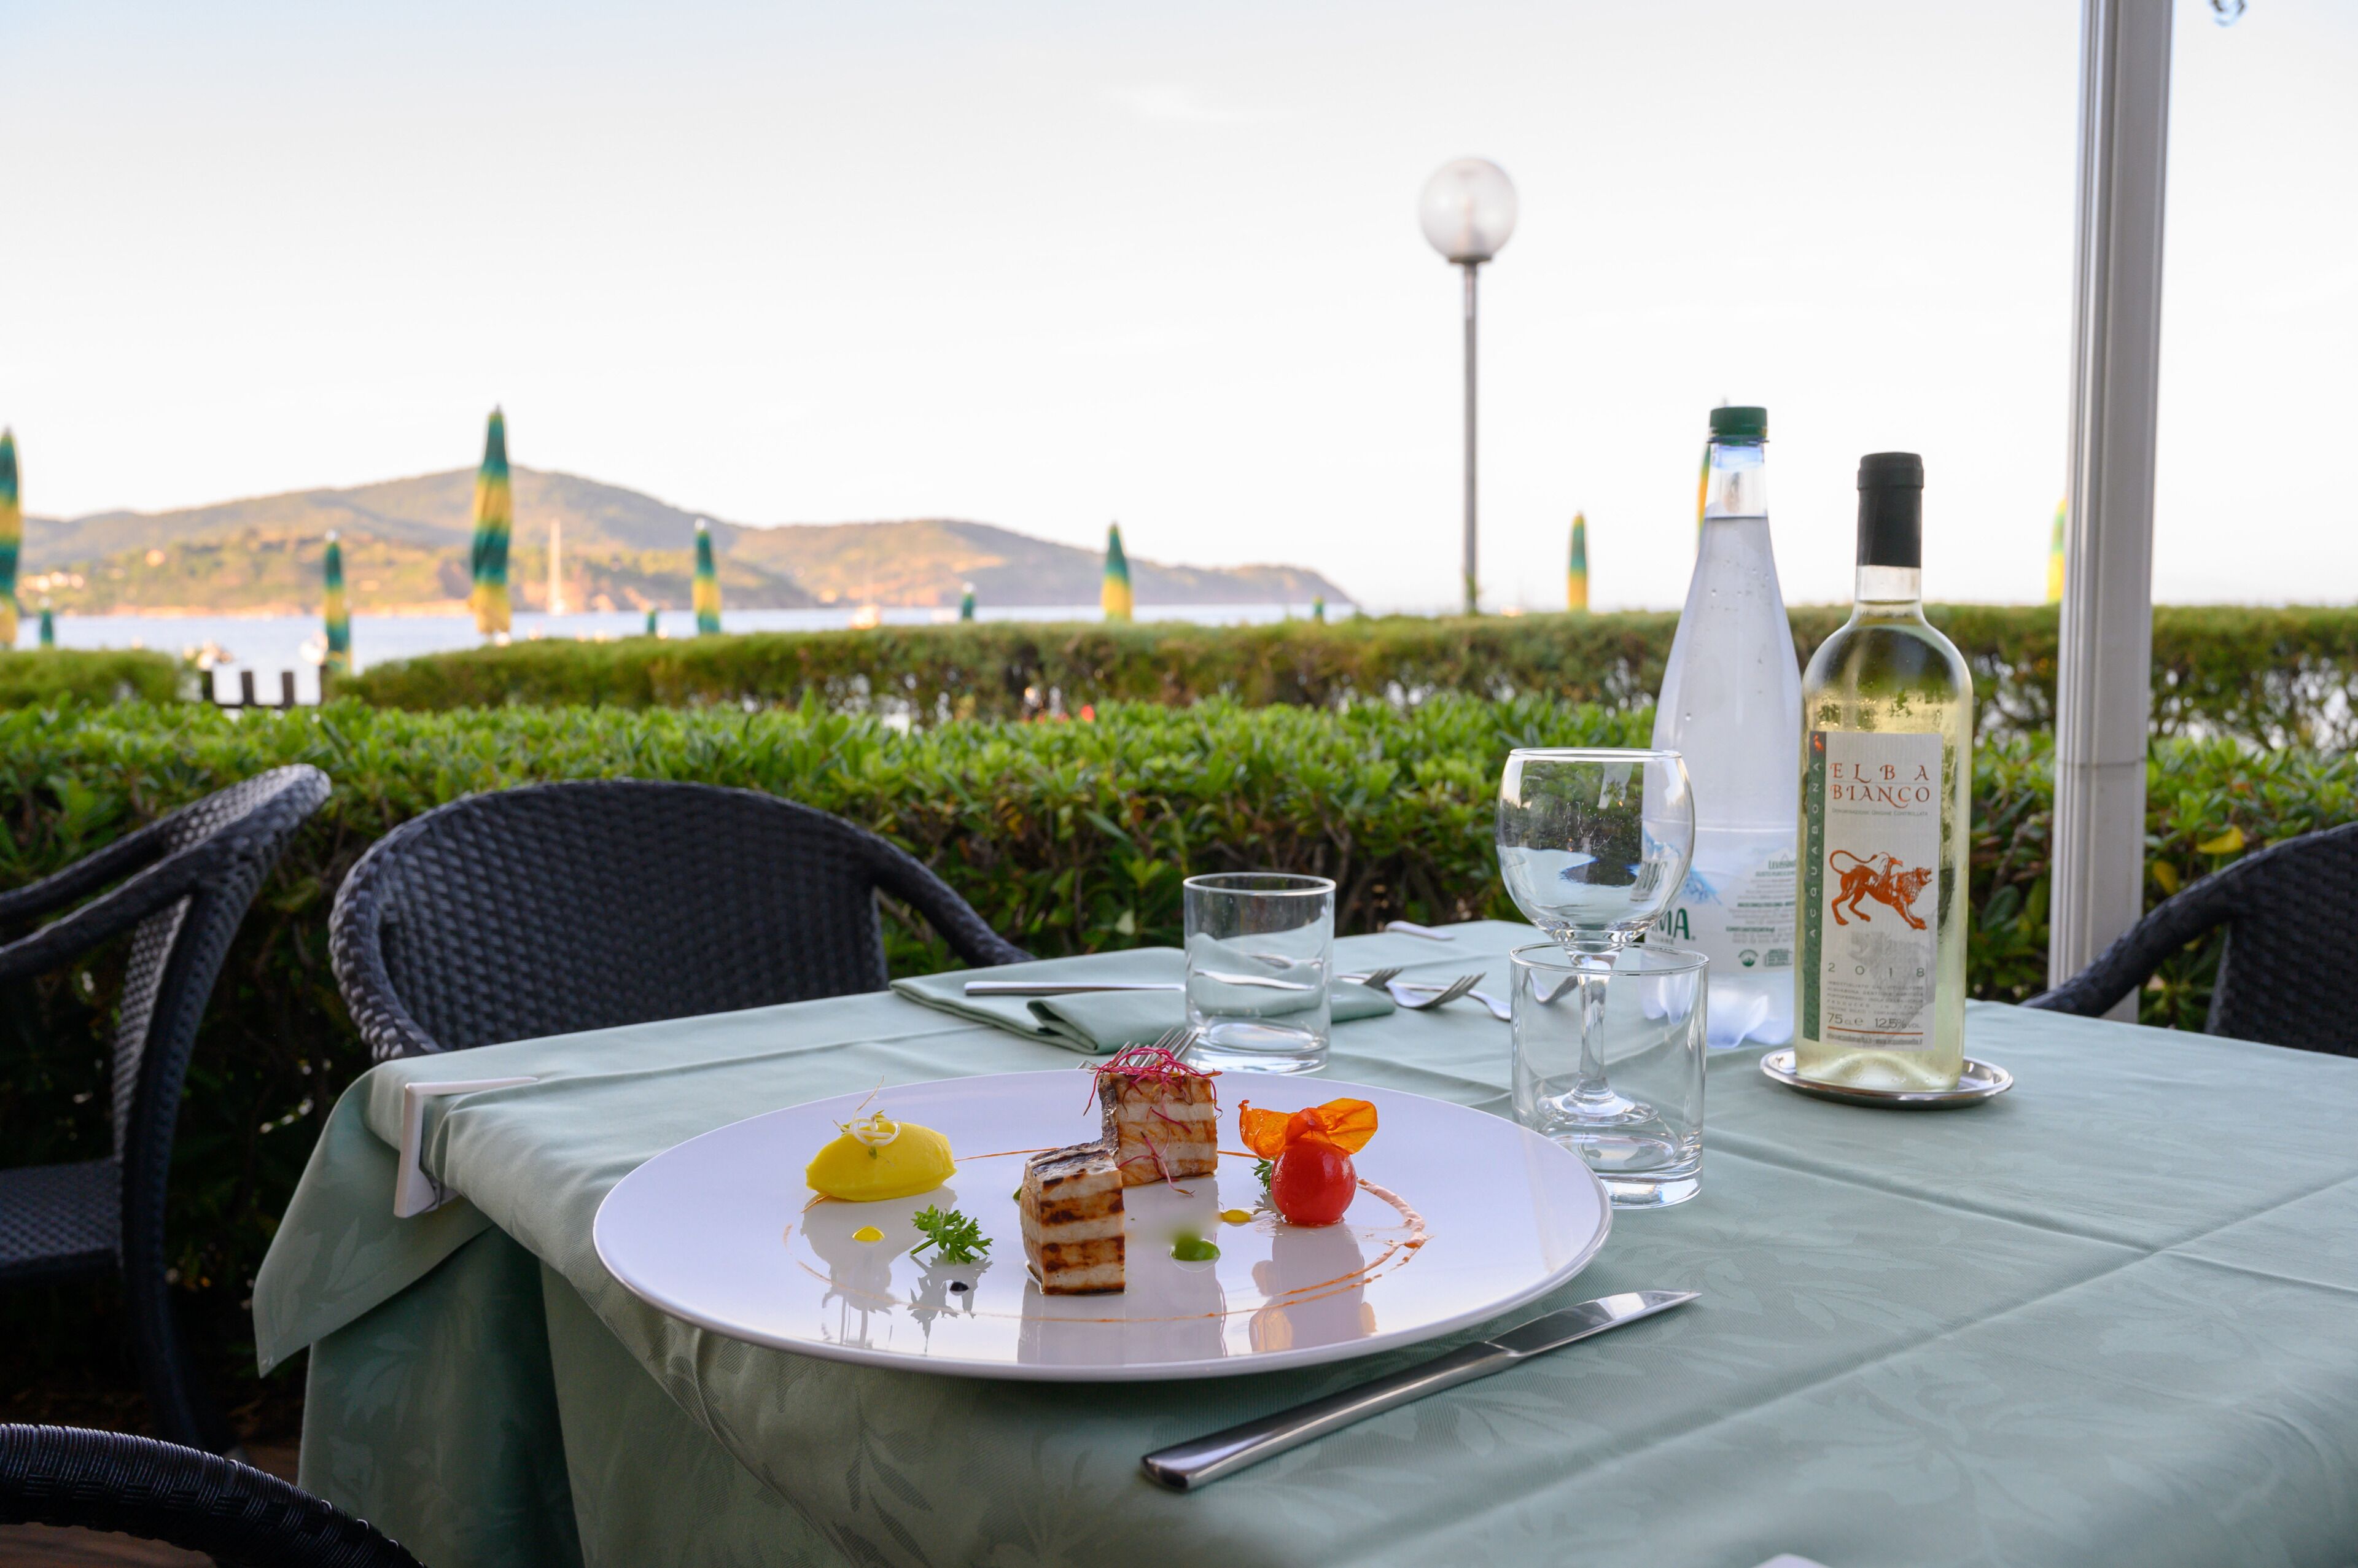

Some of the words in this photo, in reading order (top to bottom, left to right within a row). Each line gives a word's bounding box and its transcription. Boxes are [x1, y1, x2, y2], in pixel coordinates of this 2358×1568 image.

[1829, 763, 1929, 783] ELBA
[1830, 784, 1930, 809] BIANCO
[1809, 763, 1819, 938] ACQUABONA
[1827, 1012, 1843, 1024] 75
